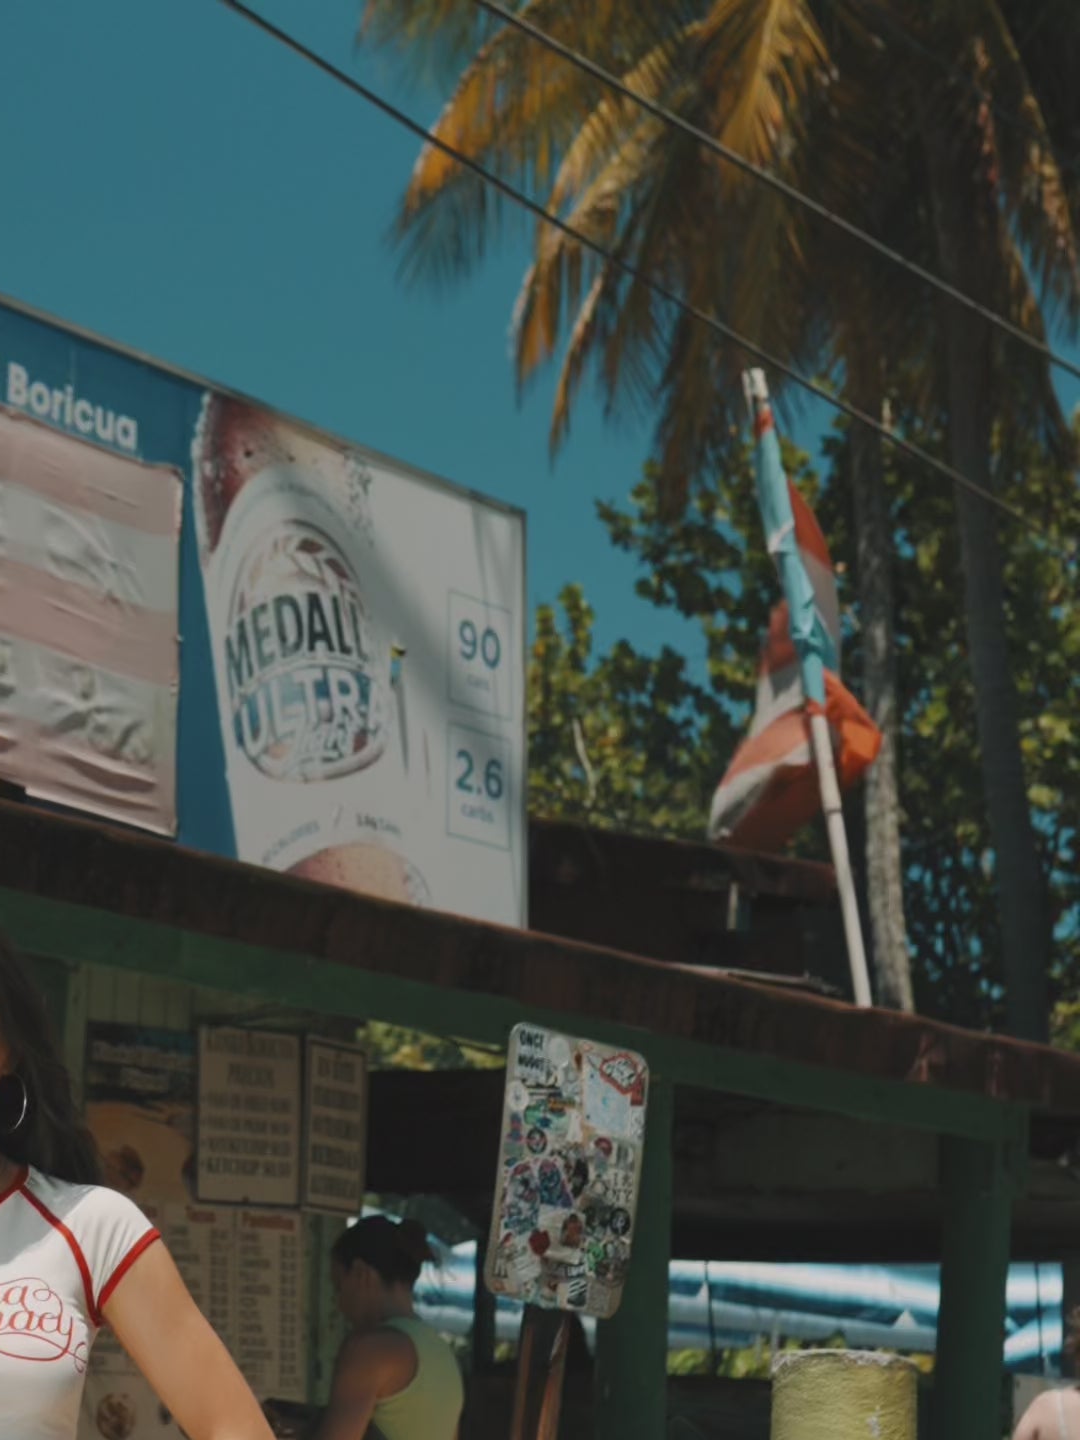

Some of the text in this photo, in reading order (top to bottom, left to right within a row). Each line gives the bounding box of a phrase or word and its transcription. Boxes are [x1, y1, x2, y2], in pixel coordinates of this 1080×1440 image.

[7, 361, 138, 450] Boricua
[458, 619, 501, 670] 90
[455, 749, 503, 800] 2.6
